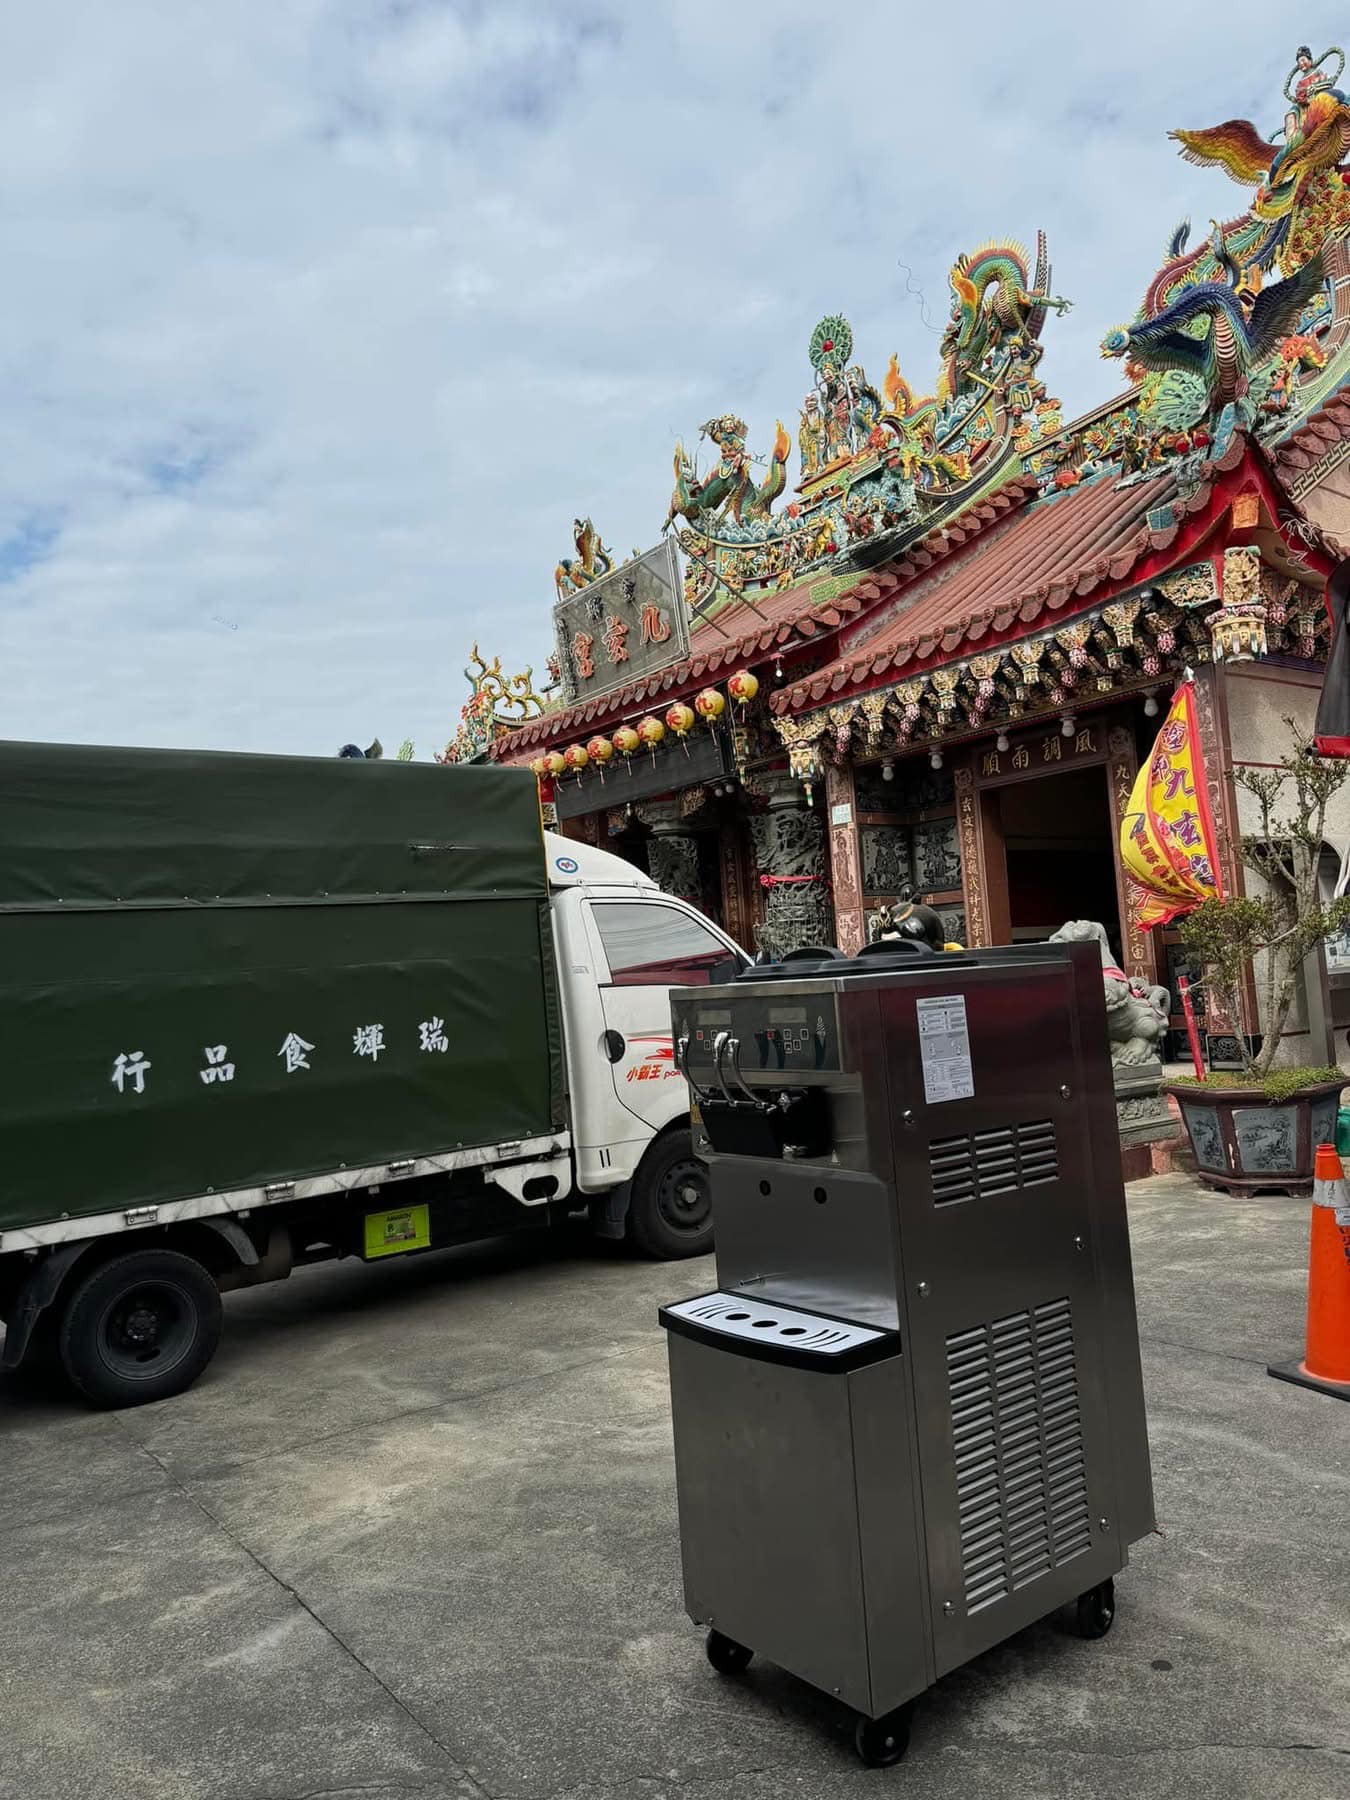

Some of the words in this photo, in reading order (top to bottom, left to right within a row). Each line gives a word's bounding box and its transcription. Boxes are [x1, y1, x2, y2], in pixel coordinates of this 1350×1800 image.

[982, 728, 1097, 776] 風調雨順
[626, 1063, 663, 1082] 小霸王
